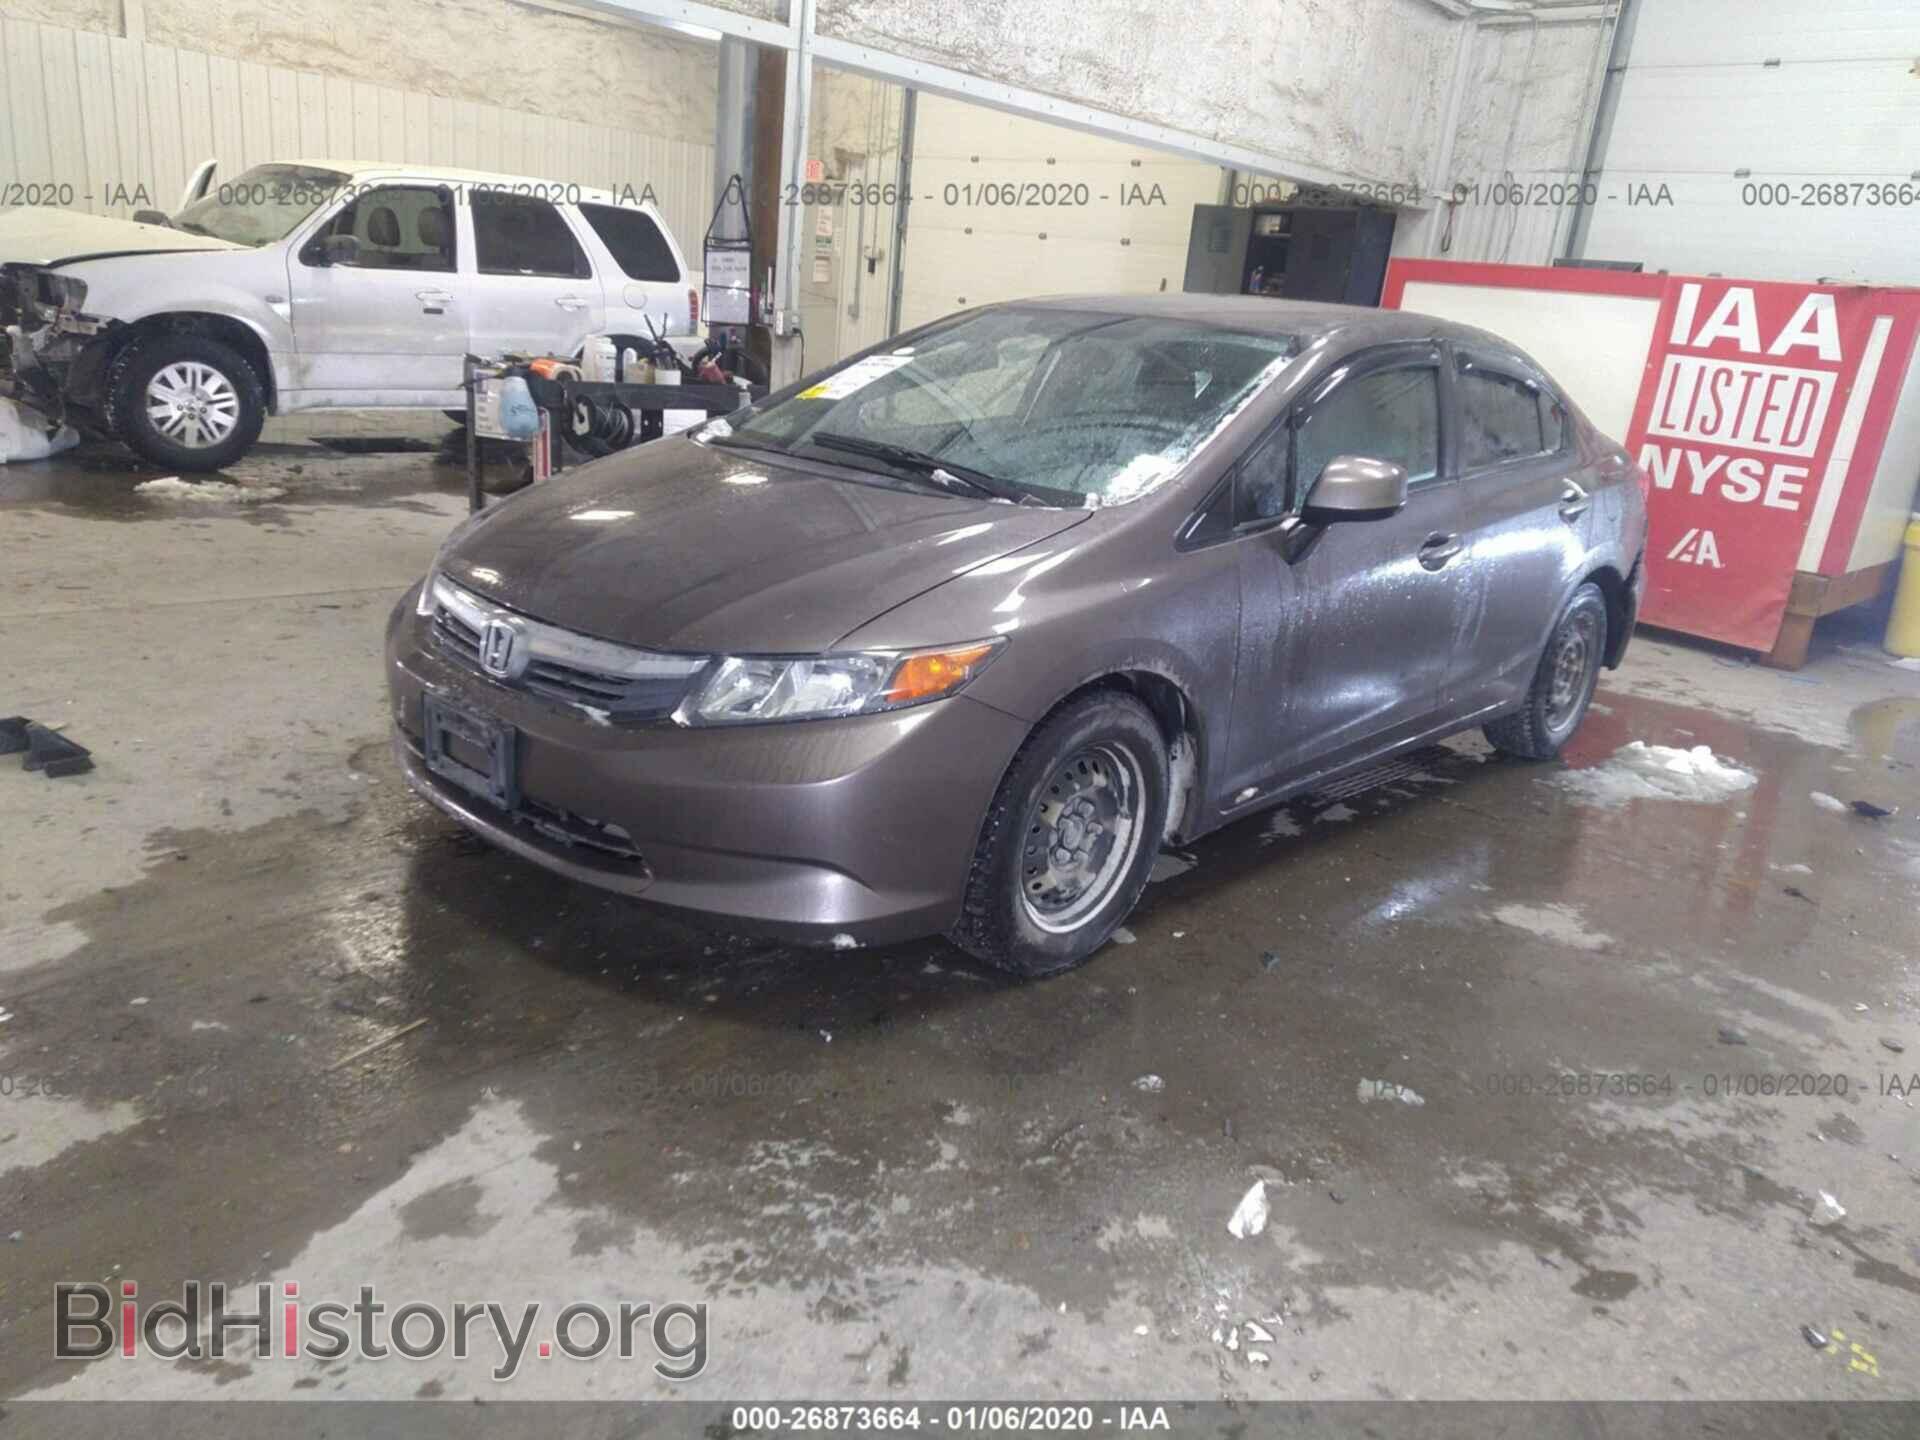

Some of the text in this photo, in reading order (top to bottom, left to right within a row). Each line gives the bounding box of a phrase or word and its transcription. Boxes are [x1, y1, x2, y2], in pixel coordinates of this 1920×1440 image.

[1668, 282, 1843, 362] IAA
[1658, 362, 1821, 448] LISTED
[1637, 443, 1809, 511] NYSE
